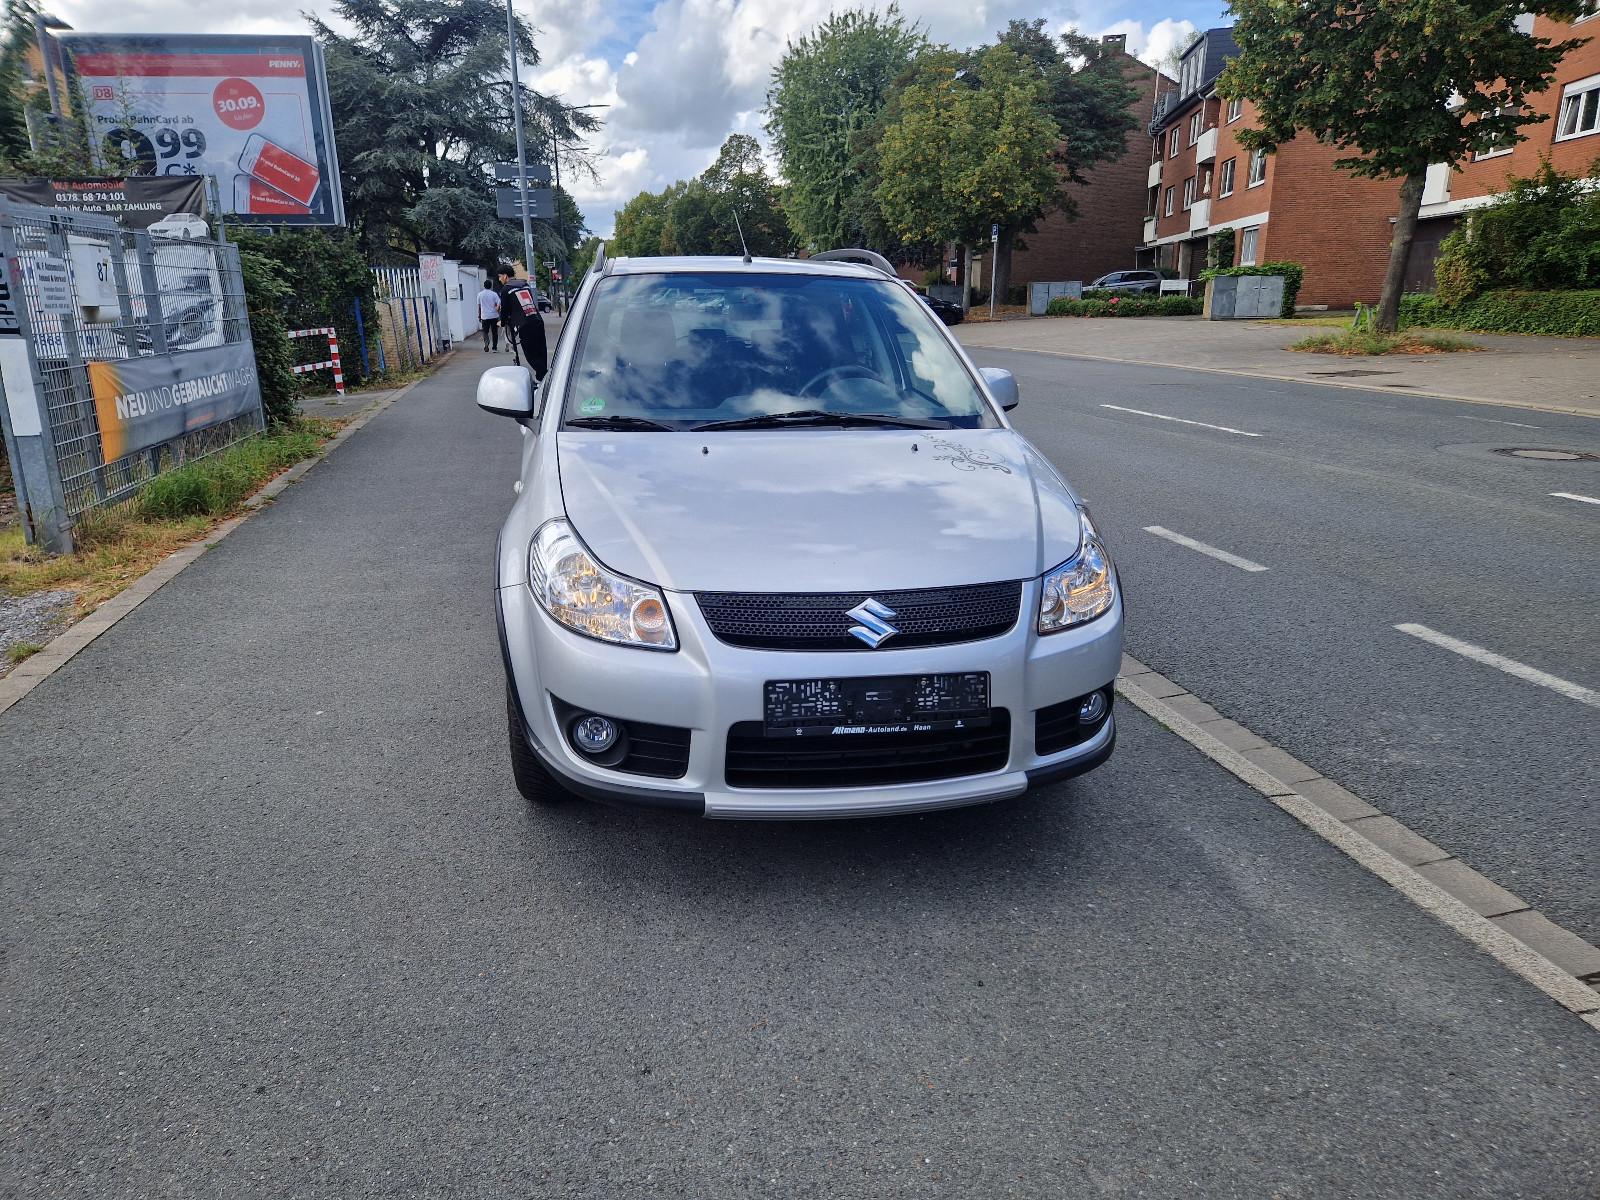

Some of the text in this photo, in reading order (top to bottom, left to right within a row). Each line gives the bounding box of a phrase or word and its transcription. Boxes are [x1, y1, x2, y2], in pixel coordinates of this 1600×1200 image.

[95, 88, 111, 98] DB
[217, 96, 260, 112] 30.09.
[181, 115, 194, 124] ab
[72, 181, 125, 190] Automobile
[56, 191, 126, 202] 0178 68 74 101
[82, 204, 101, 212] Auto
[105, 204, 122, 212] BAR
[123, 202, 162, 211] ZAHLUNG
[96, 262, 108, 282] 87
